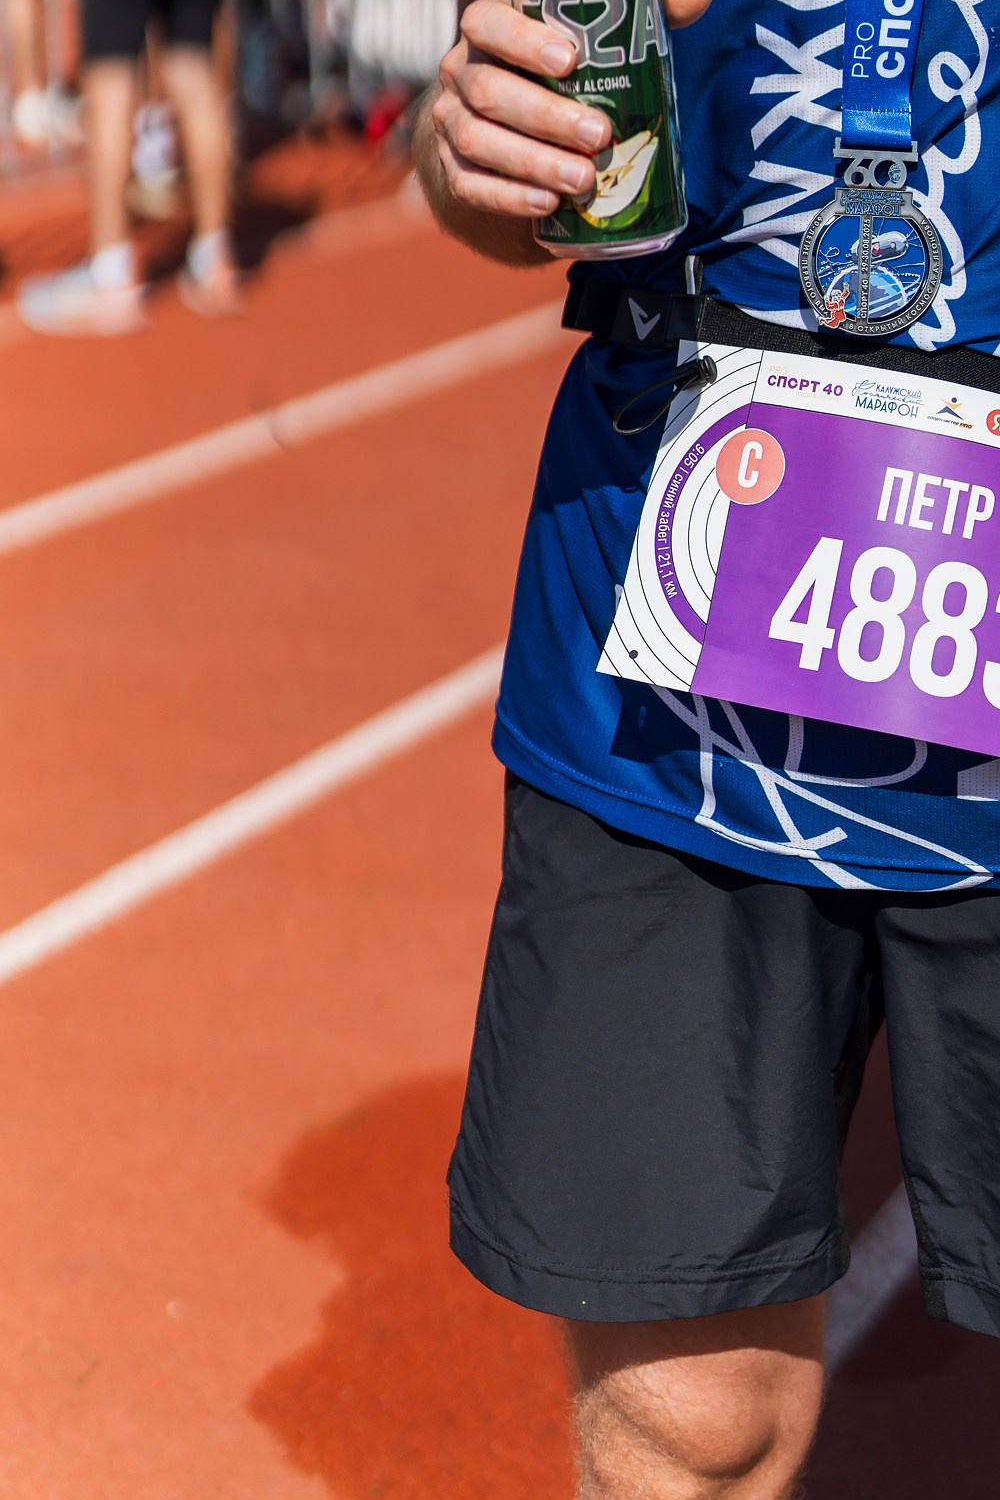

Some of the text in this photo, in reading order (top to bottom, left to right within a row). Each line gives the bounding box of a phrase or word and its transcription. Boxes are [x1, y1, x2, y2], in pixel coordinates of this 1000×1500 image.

[851, 21, 877, 79] PRO
[558, 74, 632, 93] NON ALCOHOL
[844, 156, 907, 190] 60
[845, 202, 901, 217] МАРАФОН
[801, 259, 817, 299] ПЕРВОГО
[857, 318, 905, 333] ОТКРЫТЫЙ
[906, 288, 934, 320] КОСМОС
[920, 219, 940, 260] ЛЕОНОВА
[767, 374, 821, 393] СПОРТ
[822, 383, 844, 397] 40
[875, 384, 922, 399] КАЛУЖСКИЙ
[855, 395, 919, 418] МАРАФОН
[683, 443, 705, 469] 9:05
[663, 473, 684, 509] синий
[876, 466, 996, 540] ПЕТР
[657, 511, 671, 544] забег
[658, 553, 674, 578] 21,1
